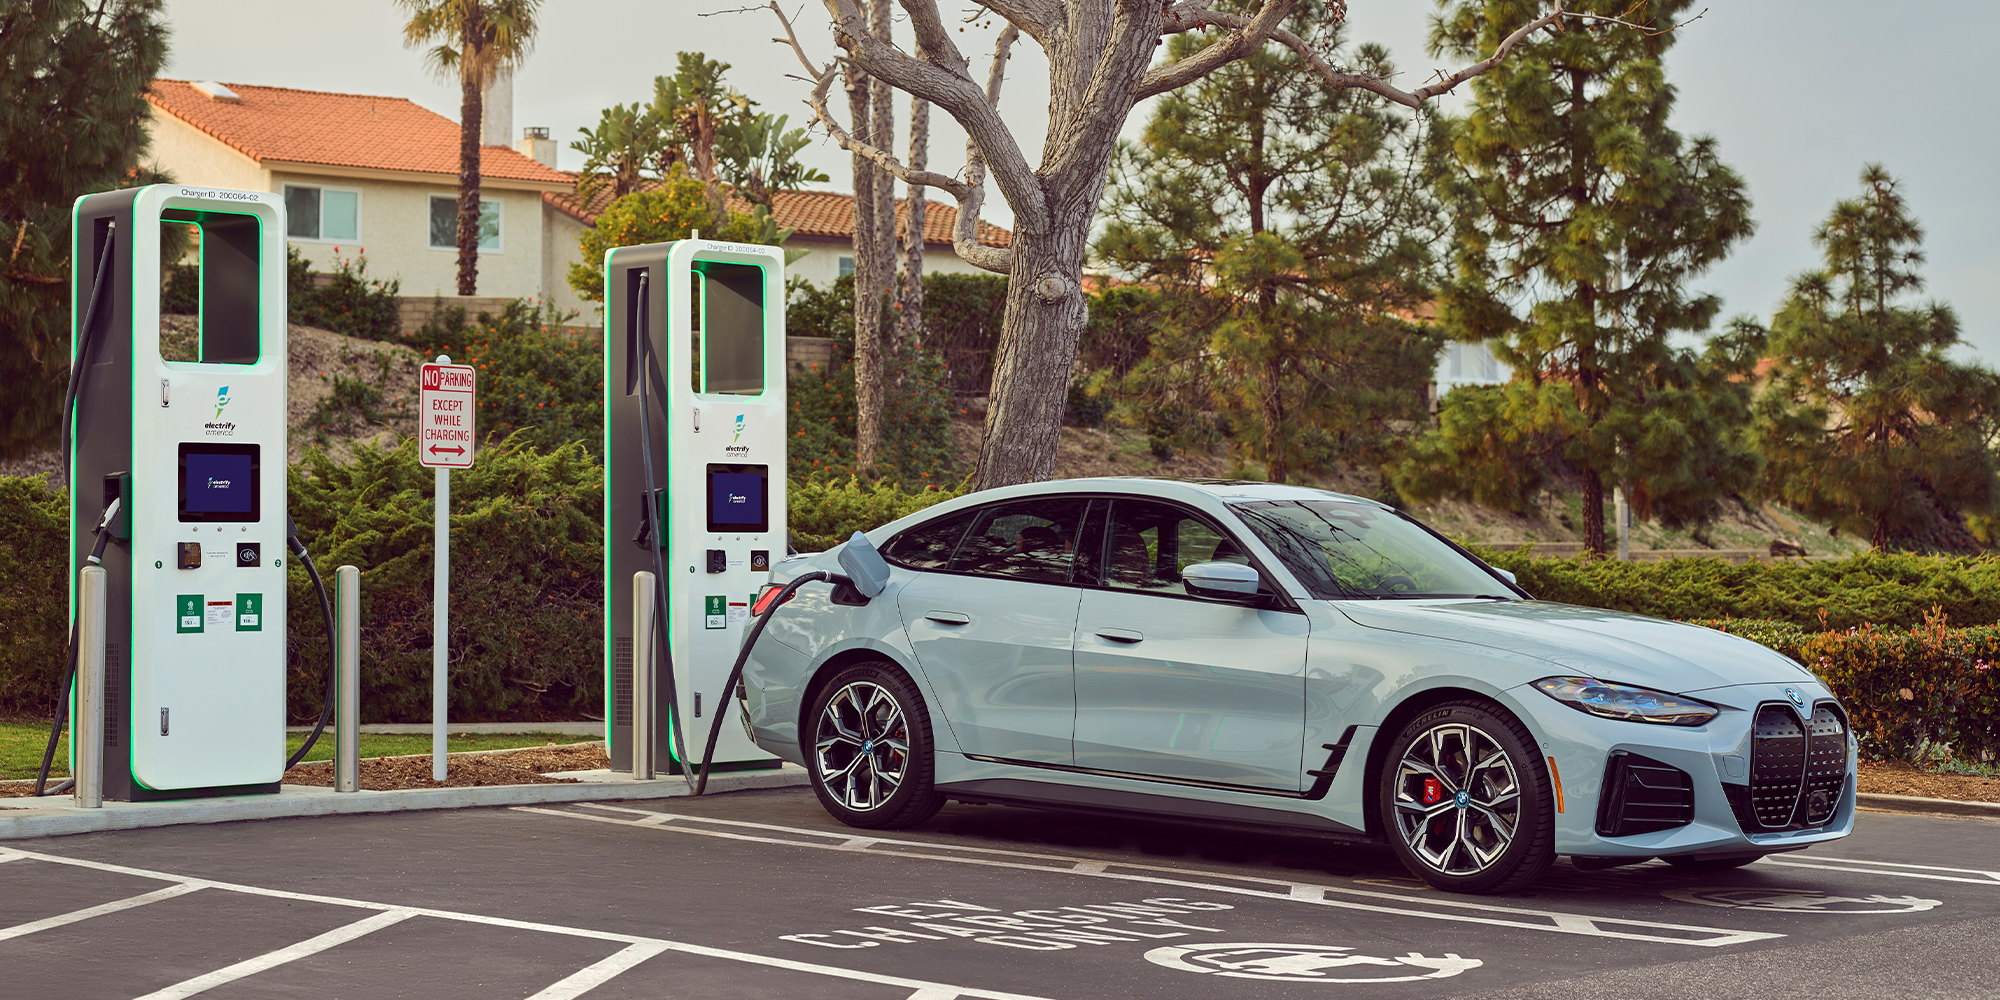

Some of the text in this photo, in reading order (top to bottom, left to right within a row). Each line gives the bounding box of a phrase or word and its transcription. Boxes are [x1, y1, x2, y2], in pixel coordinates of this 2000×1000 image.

[181, 188, 259, 201] Charger ID 200064-02
[707, 243, 727, 252] Charger
[424, 370, 472, 388] NO PARKING
[432, 399, 463, 411] EXCEPT
[204, 422, 236, 431] electrify
[434, 414, 461, 426] WHILE
[425, 428, 470, 442] CHARGING
[725, 445, 750, 454] electrify
[841, 669, 877, 682] MICHELIN
[1406, 710, 1450, 735] MICHELIN
[852, 899, 1002, 920] EV
[778, 897, 1235, 949] CHARGING
[974, 917, 1226, 951] ONLY
